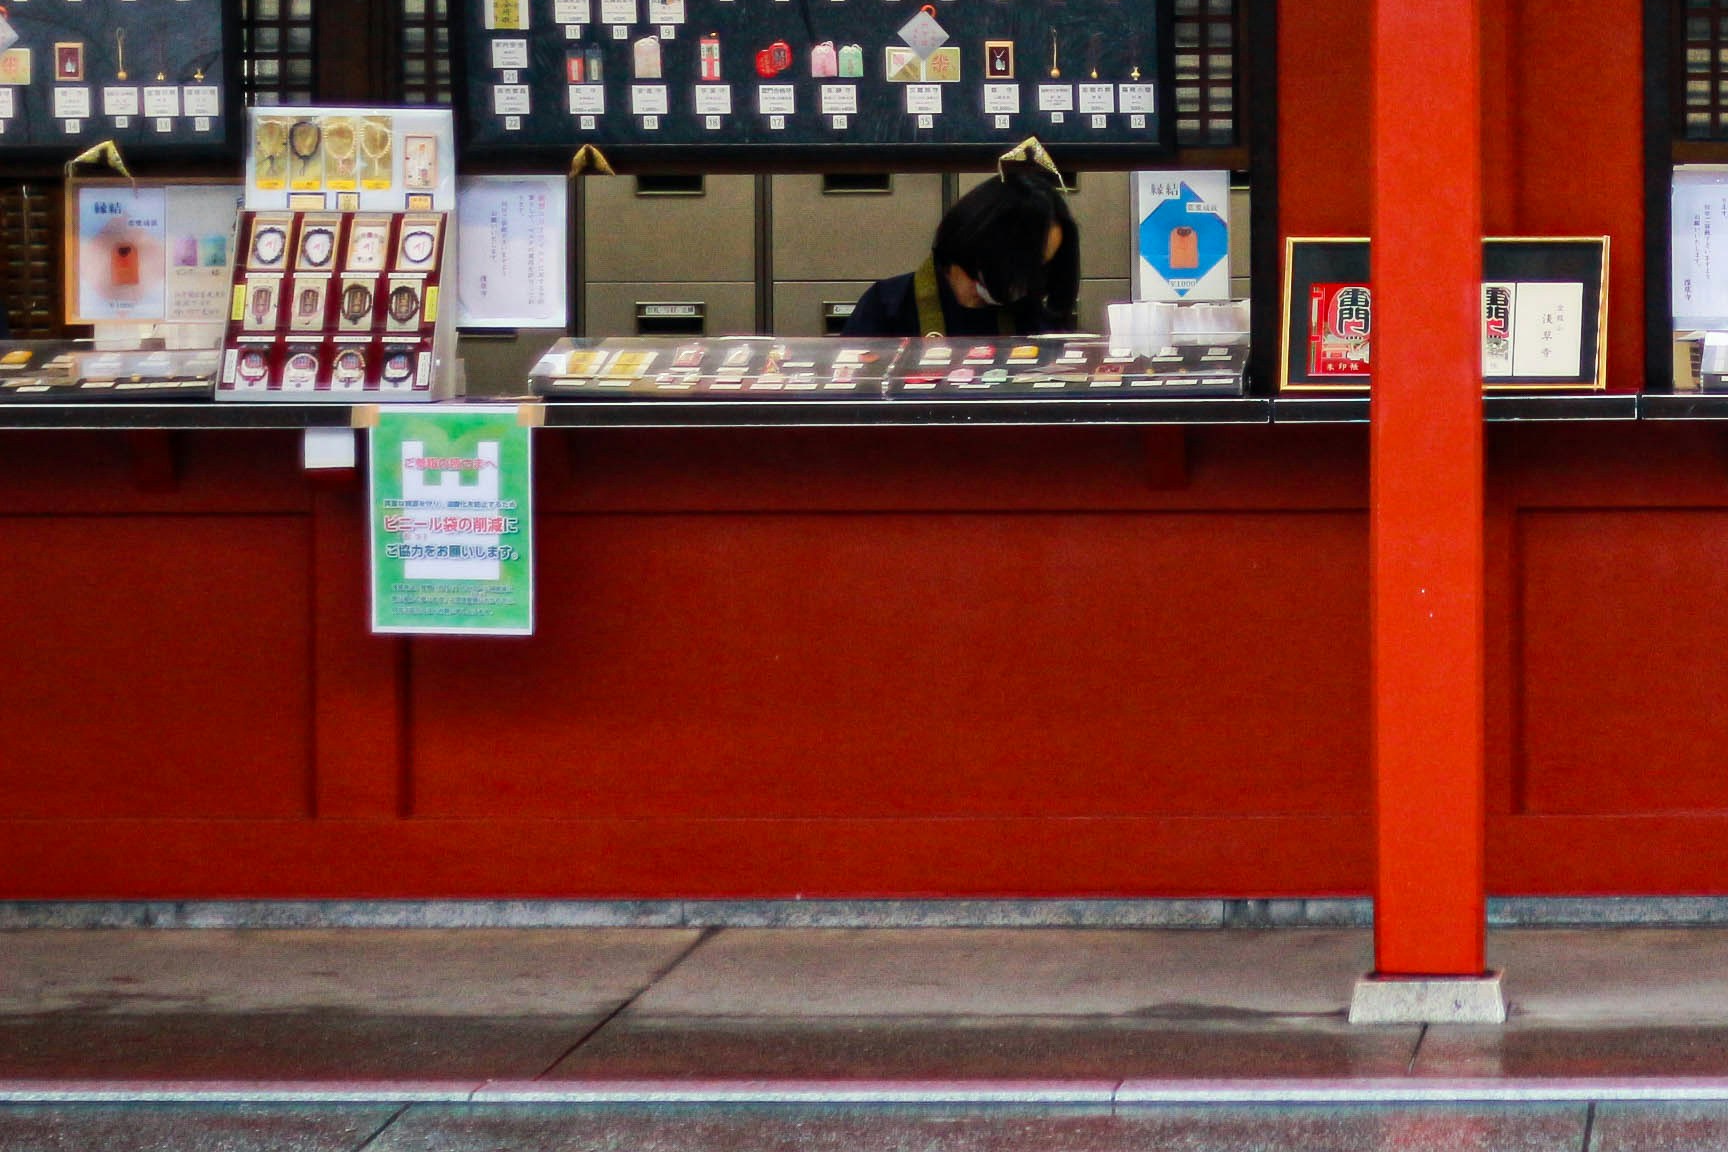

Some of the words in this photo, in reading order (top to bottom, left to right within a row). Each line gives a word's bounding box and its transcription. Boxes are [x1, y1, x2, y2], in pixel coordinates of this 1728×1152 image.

[384, 516, 519, 533] ビニール袋の削減に
[386, 544, 520, 561] ご協力をお願いします。
